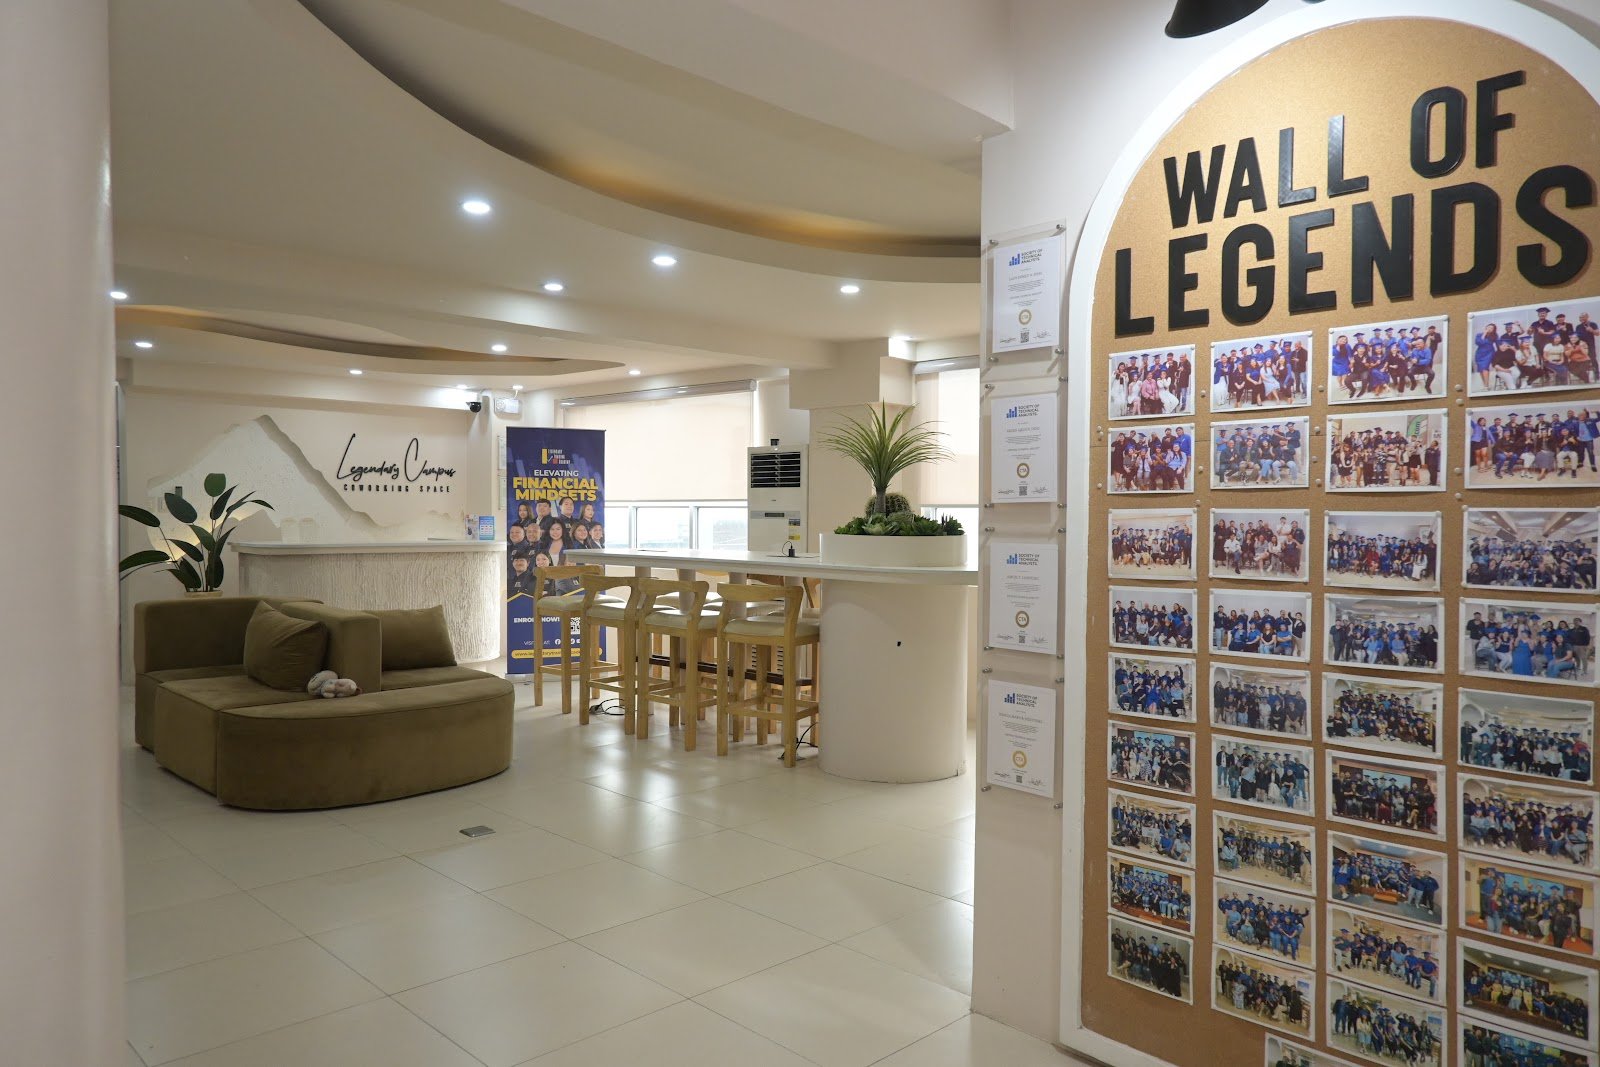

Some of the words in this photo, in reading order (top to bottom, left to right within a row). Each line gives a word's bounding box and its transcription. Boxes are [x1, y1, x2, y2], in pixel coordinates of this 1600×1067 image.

[1163, 114, 1369, 229] WALL
[1410, 70, 1526, 179] OF
[1115, 164, 1595, 339] LEGENDS
[337, 433, 399, 482] Legendary
[404, 438, 456, 482] Campus
[533, 469, 579, 477] ELEVATING
[343, 484, 409, 492] COWORKING
[420, 485, 450, 493] SPACE
[513, 477, 599, 490] FINANCIAL
[515, 489, 597, 501] MINDSETS
